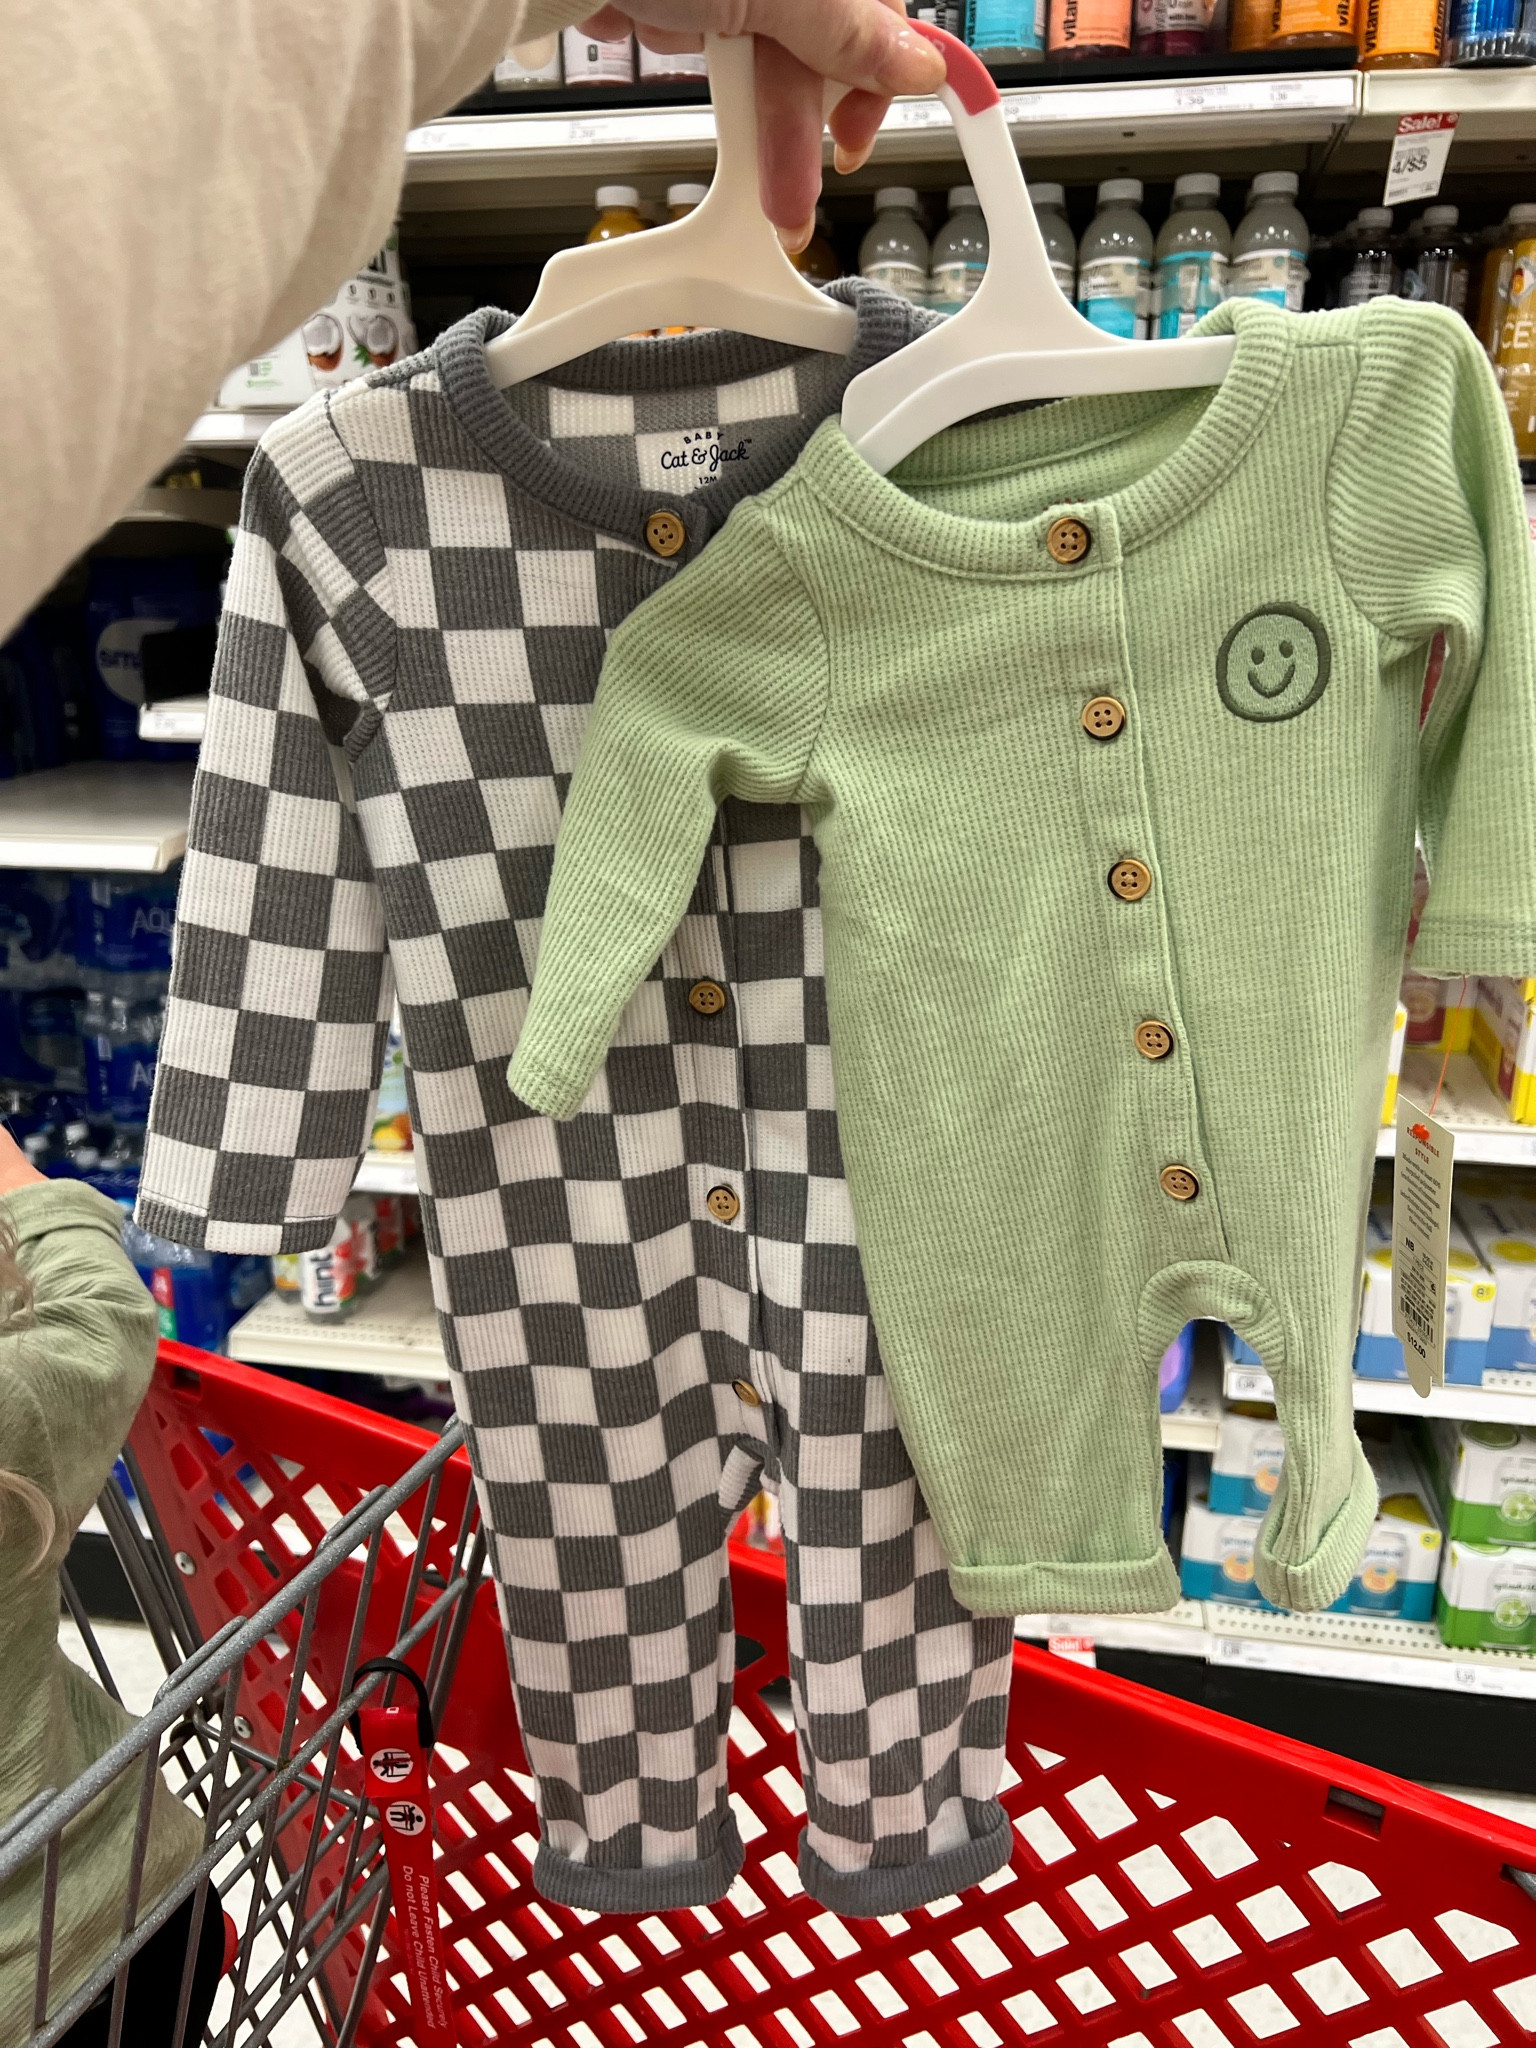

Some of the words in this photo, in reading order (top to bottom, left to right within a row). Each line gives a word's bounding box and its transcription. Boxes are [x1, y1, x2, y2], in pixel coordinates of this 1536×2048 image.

[1398, 114, 1443, 133] Sale!
[683, 431, 724, 445] BABY
[661, 451, 689, 470] Cat
[691, 448, 707, 465] &
[699, 476, 717, 485] 12M
[1415, 1147, 1430, 1165] STYLE
[1405, 1237, 1415, 1252] NB
[310, 1253, 337, 1307] hint
[1407, 1331, 1426, 1359] $12.00
[403, 1865, 414, 1882] Do
[405, 1884, 416, 1904] not
[419, 1875, 430, 1914] Please
[408, 1905, 418, 1938] Leave
[424, 1916, 435, 1954] Fasten
[413, 1940, 426, 1970] Child
[429, 1955, 441, 1985] Child
[418, 1970, 436, 2030] Unattended
[434, 1985, 449, 2029] Securely
